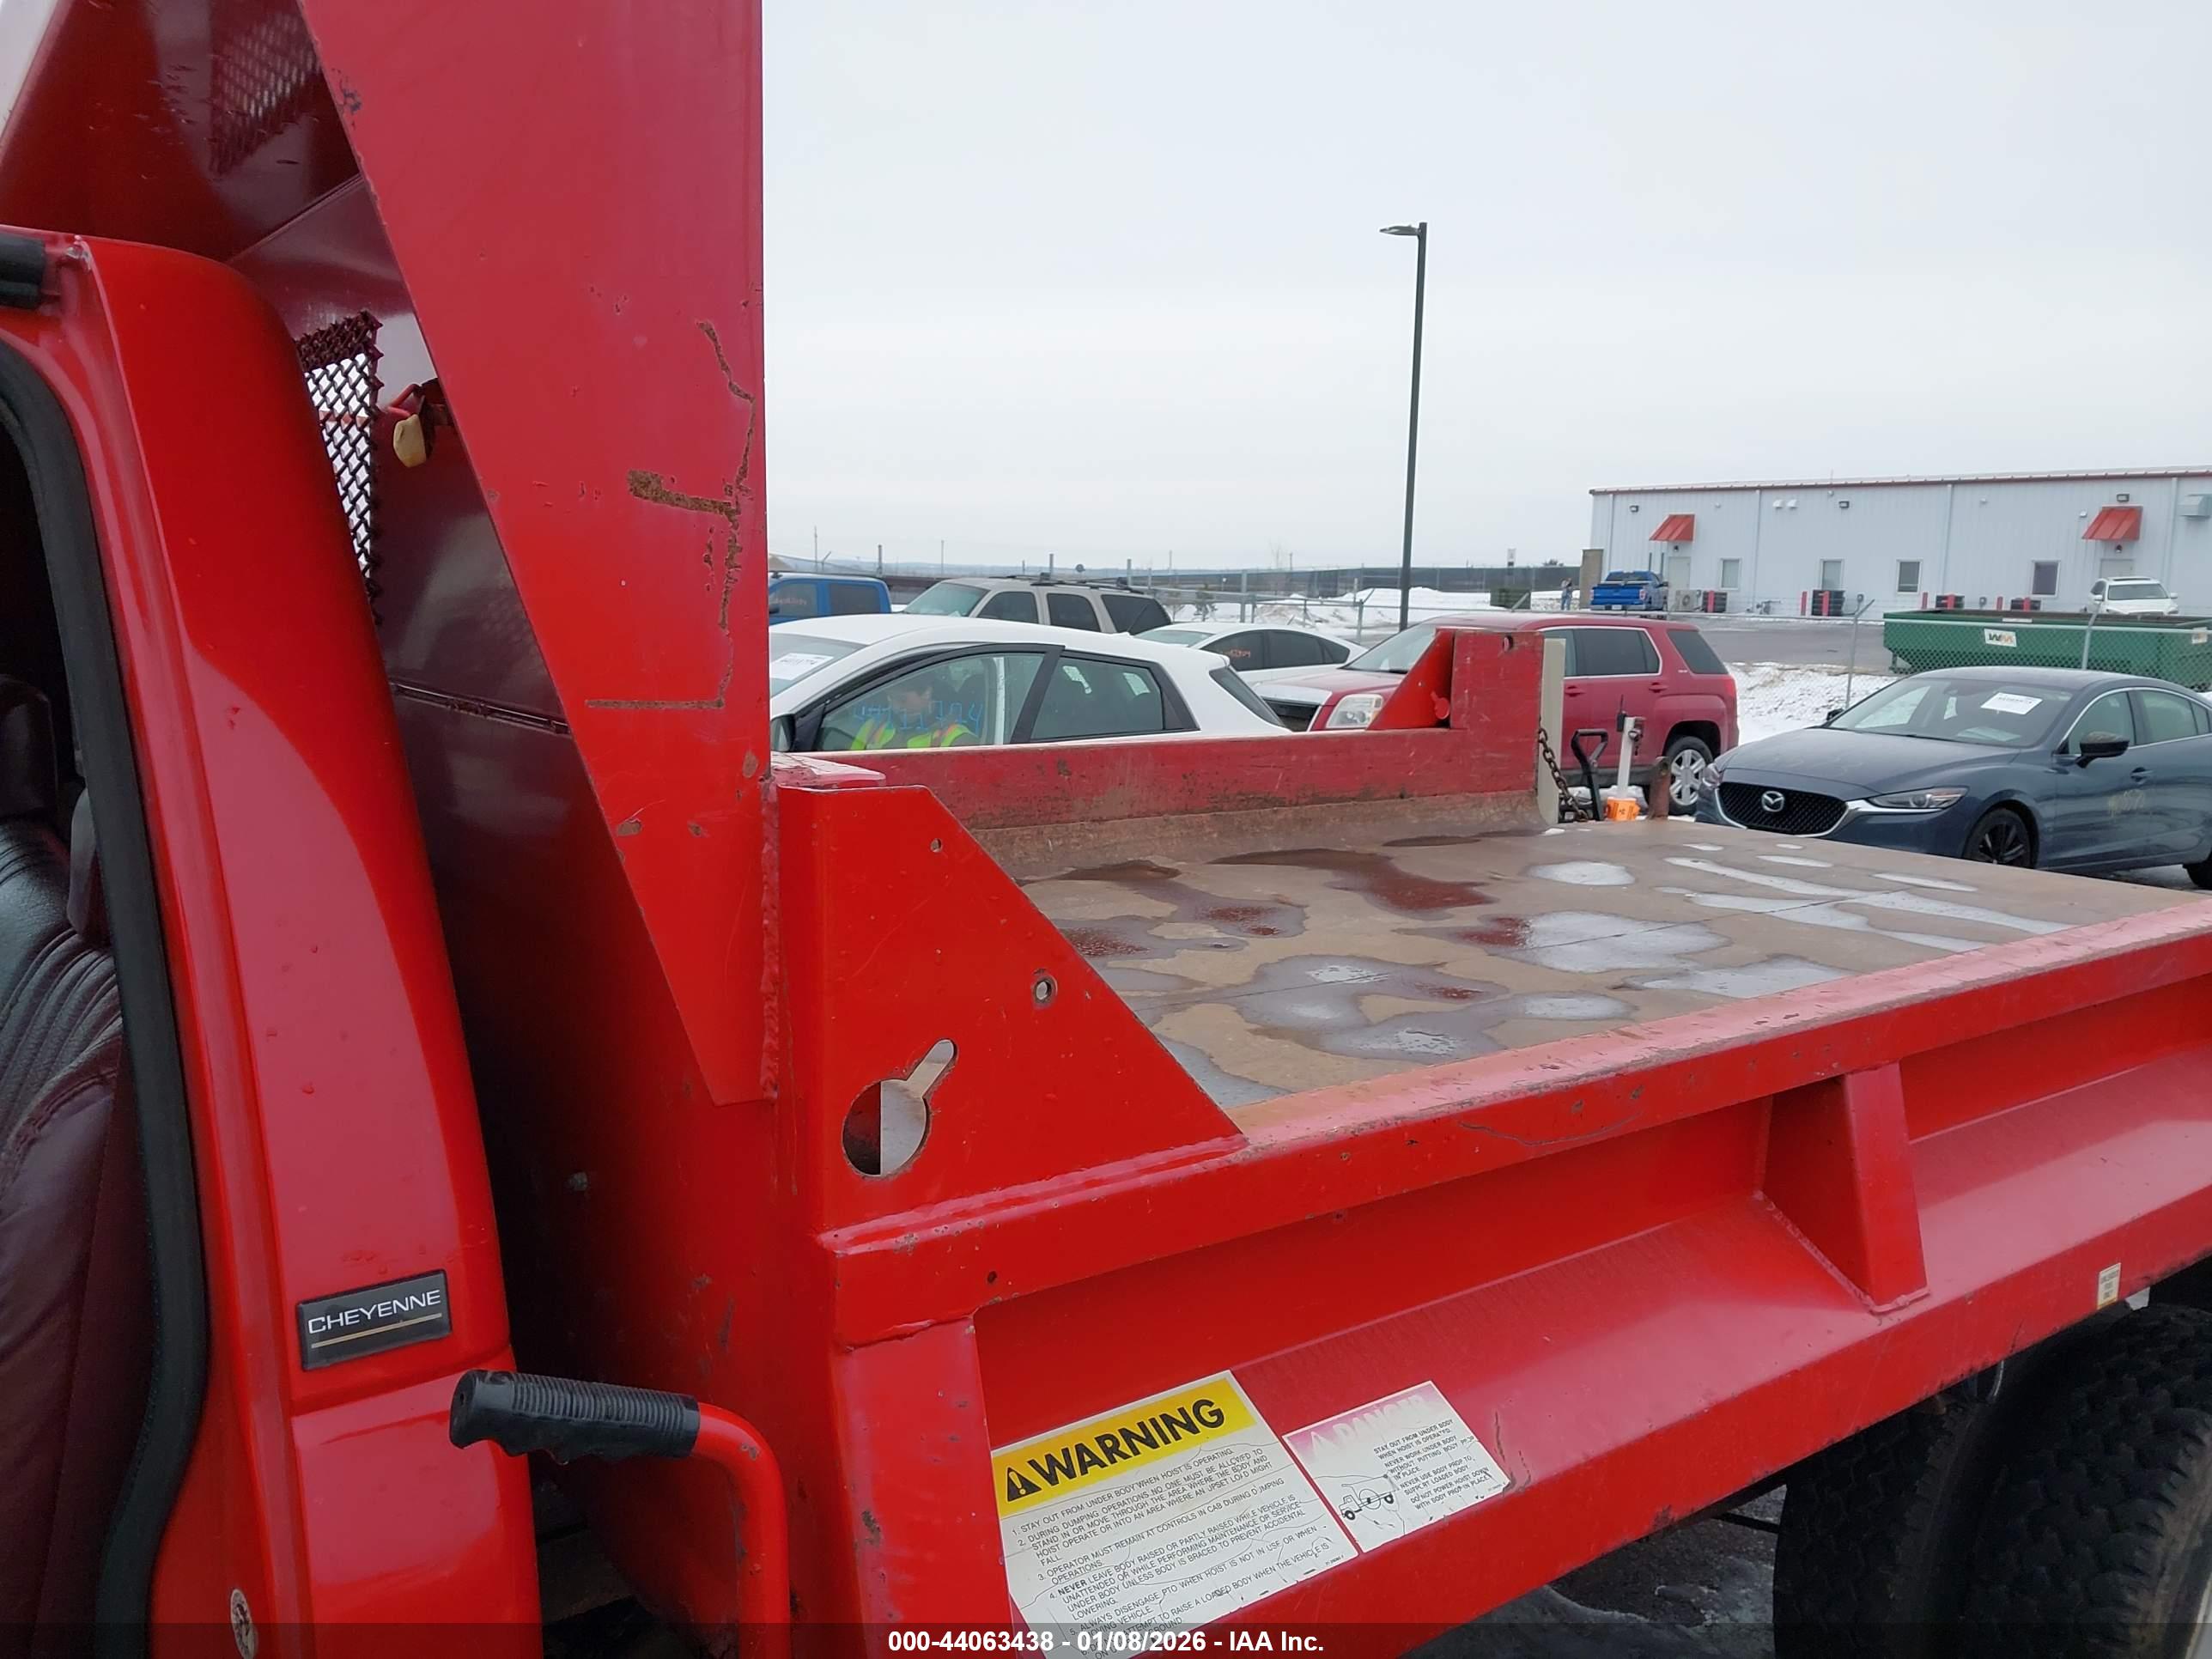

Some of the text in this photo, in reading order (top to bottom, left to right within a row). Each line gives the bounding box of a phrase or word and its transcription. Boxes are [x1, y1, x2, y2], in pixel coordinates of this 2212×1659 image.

[308, 1289, 441, 1334] CHEYENNE
[1027, 1399, 1224, 1486] WARNING
[1374, 1444, 1388, 1453] STAY
[1401, 1432, 1418, 1442] FROM
[1418, 1425, 1438, 1436] UNDER
[1438, 1419, 1453, 1427] BODY
[1379, 1449, 1396, 1460] WHEN
[1397, 1442, 1414, 1452] HOIST
[1385, 1435, 1457, 1467] NEVER WORK UNDER BODY
[1389, 1460, 1414, 1474] WITHOUT
[1417, 1449, 1441, 1462] PUTTING
[1443, 1442, 1458, 1451] BODY
[1020, 1520, 1041, 1532] STAY
[1042, 1513, 1060, 1524] OUT
[1061, 1504, 1084, 1517] FROM
[1086, 1493, 1114, 1508] UNDER
[1115, 1485, 1135, 1497] BODY
[1137, 1475, 1159, 1489] WHEN
[1161, 1466, 1183, 1479] HOIST
[1028, 1525, 1060, 1542] DURING
[1062, 1510, 1099, 1529] DUMPING
[1150, 1485, 1163, 1495] NO
[1164, 1478, 1182, 1489] ONE
[1183, 1470, 1204, 1482] MUST
[1206, 1465, 1216, 1474] BE
[1253, 1448, 1263, 1456] TO
[1031, 1535, 1059, 1550] STAND
[1072, 1525, 1085, 1534] OR
[1087, 1516, 1109, 1529] MOVE
[1112, 1501, 1149, 1519] THROUGH
[1150, 1494, 1165, 1503] THE
[1166, 1485, 1187, 1497] AREA
[1188, 1475, 1214, 1489] WHERE
[1216, 1469, 1230, 1479] THE
[1231, 1461, 1252, 1473] BODY
[1252, 1455, 1268, 1465] AND
[1400, 1477, 1419, 1488] NEVER
[1420, 1472, 1432, 1480] USE
[1432, 1465, 1448, 1474] BODY
[1449, 1459, 1463, 1468] PROP
[1404, 1480, 1429, 1495] SUPPORT
[1431, 1471, 1453, 1483] LOADED
[1415, 1500, 1430, 1510] WITH
[1431, 1493, 1446, 1502] BODY
[1447, 1486, 1463, 1495] PROP
[1420, 1490, 1432, 1499] NOT
[1433, 1481, 1453, 1493] POWER
[1454, 1474, 1471, 1485] HOIST
[1471, 1466, 1488, 1477] DOWN
[1036, 1543, 1060, 1558] HOIST
[1062, 1529, 1098, 1548] OPERATE
[1099, 1524, 1112, 1533] OR
[1113, 1516, 1132, 1528] INTO
[1133, 1512, 1144, 1520] AN
[1146, 1502, 1165, 1516] AREA
[1166, 1492, 1193, 1506] WHERE
[1194, 1488, 1205, 1496] AN
[1250, 1462, 1273, 1474] MIGHT
[1046, 1555, 1090, 1577] OPERATOR
[1091, 1545, 1114, 1559] MUST
[1115, 1533, 1145, 1550] REMAIN
[1146, 1529, 1156, 1538] AT
[1156, 1512, 1196, 1533] CONTROLS
[1207, 1502, 1222, 1512] CAB
[1223, 1491, 1251, 1506] DURING
[1057, 1578, 1087, 1595] NEVER
[1088, 1568, 1113, 1583] LEAVE
[1114, 1559, 1137, 1573] BODY
[1137, 1547, 1165, 1563] RAISED
[1166, 1542, 1179, 1552] OR
[1179, 1530, 1206, 1545] PARTLY
[1207, 1519, 1234, 1534] RAISED
[1235, 1510, 1257, 1523] WHILE
[1062, 1501, 1300, 1603] UNATTENDED OR WHILE PERFORMING MAINTENANCE OR SERVICE
[1067, 1509, 1305, 1611] UNDER BODY UNLESS BODY IS BRACED TO PREVENT ACCIDENTAL
[1079, 1612, 1112, 1631] ALWAYS
[1114, 1592, 1159, 1616] DISENGAGE
[1162, 1585, 1178, 1596] PTO
[1180, 1573, 1202, 1589] WHEN
[1204, 1563, 1228, 1577] HOIST
[1239, 1552, 1255, 1563] NOT
[1266, 1540, 1282, 1551] USE
[1283, 1535, 1295, 1544] OR
[1296, 1526, 1317, 1539] WHEN
[1159, 1612, 1170, 1621] TO
[1171, 1602, 1194, 1616] RAISE
[1232, 1575, 1252, 1588] BODY
[1253, 1565, 1276, 1579] WHEN
[1276, 1559, 1291, 1569] THE
[1291, 1546, 1320, 1563] VEHICLE
